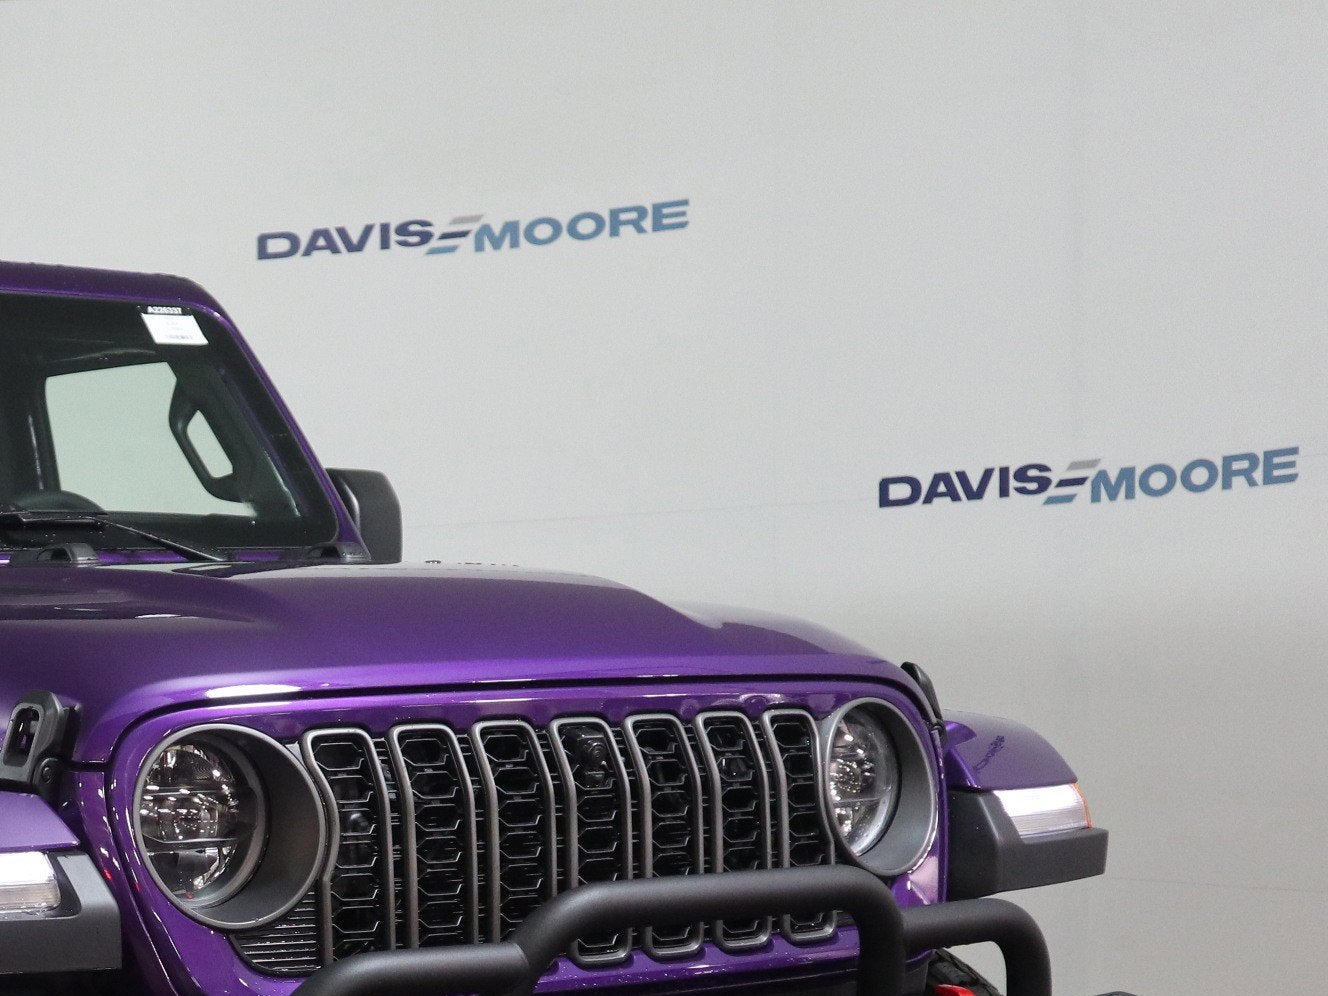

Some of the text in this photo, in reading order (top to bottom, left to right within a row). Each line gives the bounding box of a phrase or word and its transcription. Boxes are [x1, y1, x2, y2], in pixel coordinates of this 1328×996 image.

[257, 199, 690, 260] DAVIS MOORE
[878, 446, 1300, 508] DAVIS MOORE
